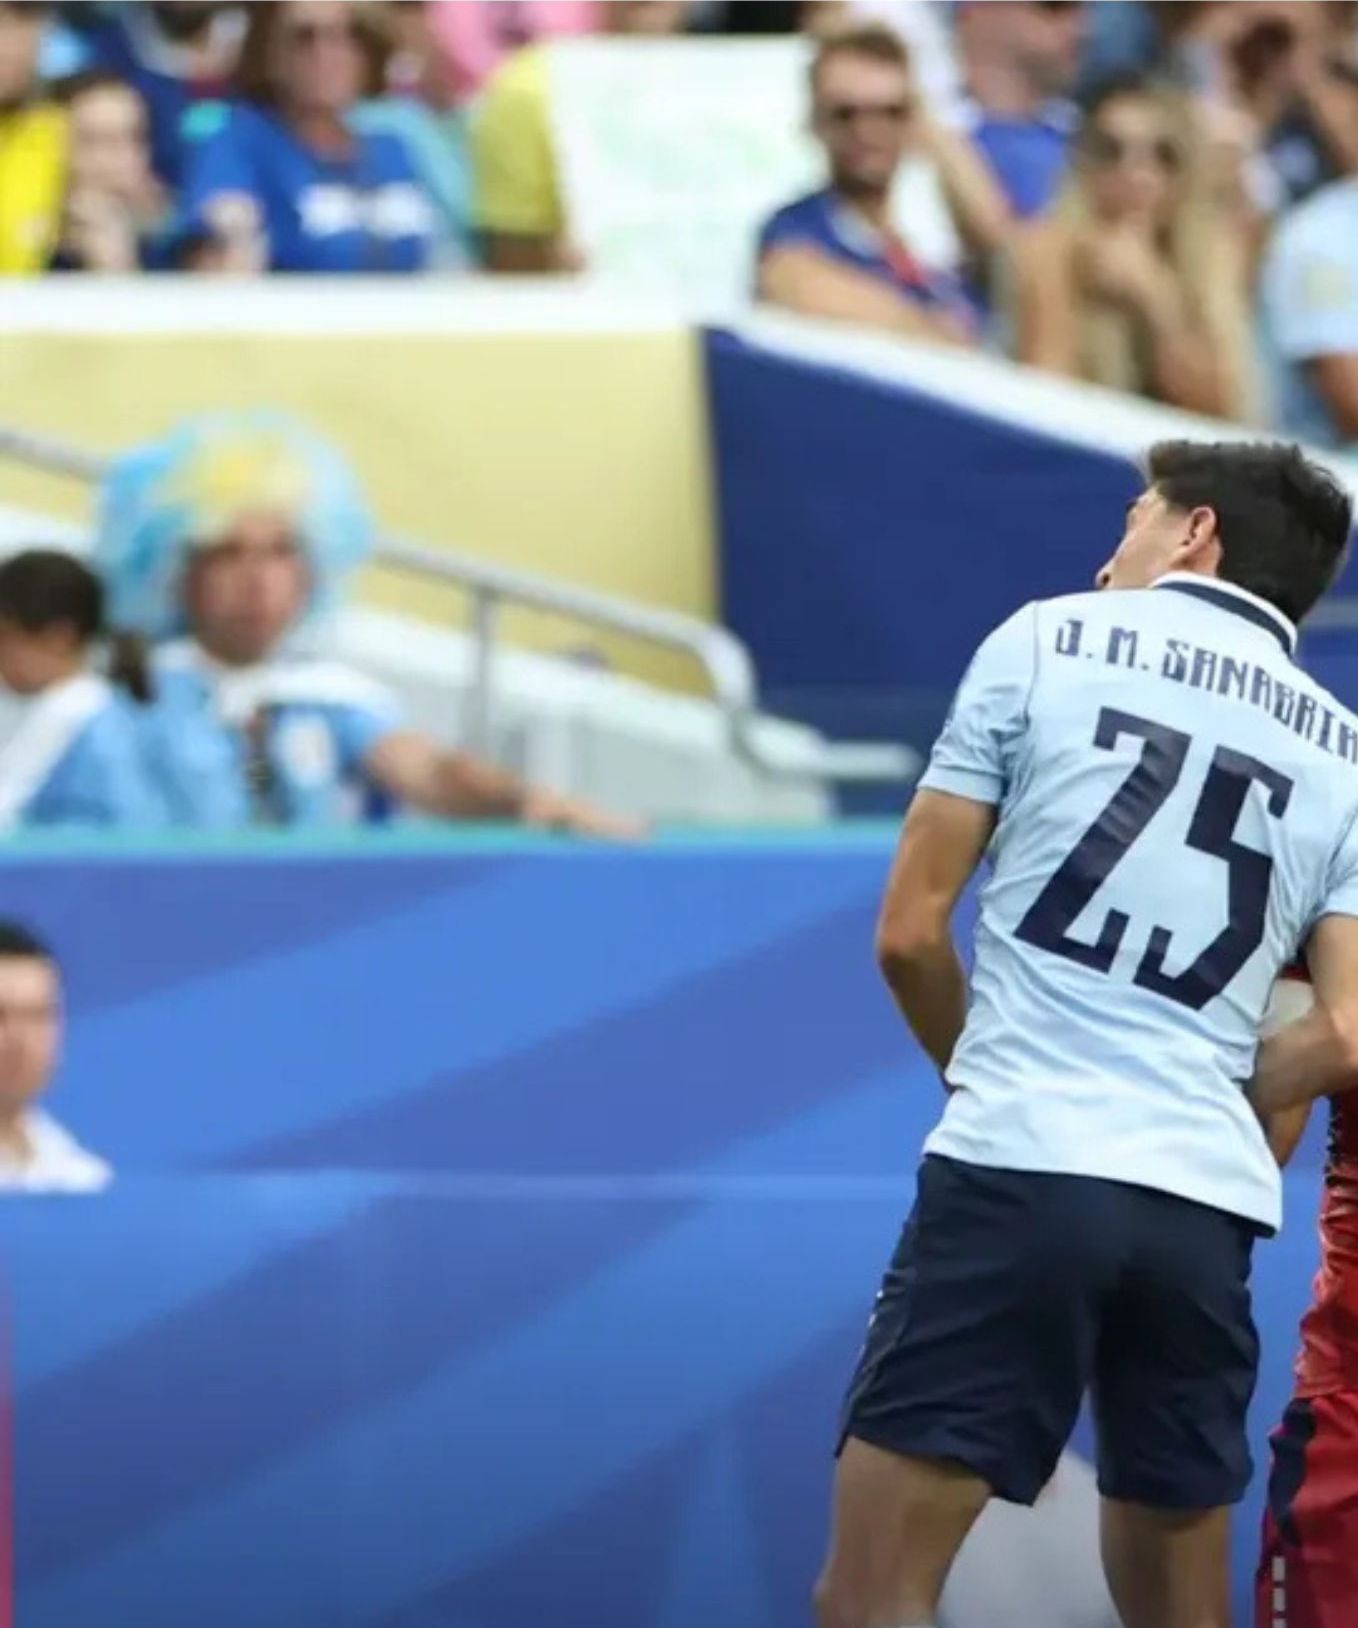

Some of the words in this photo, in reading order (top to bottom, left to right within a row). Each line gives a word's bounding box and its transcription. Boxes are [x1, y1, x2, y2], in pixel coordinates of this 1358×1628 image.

[1055, 619, 1093, 659] J.
[1106, 626, 1149, 671] M.
[1161, 639, 1358, 764] SANABRIA
[1014, 706, 1295, 1011] 25
